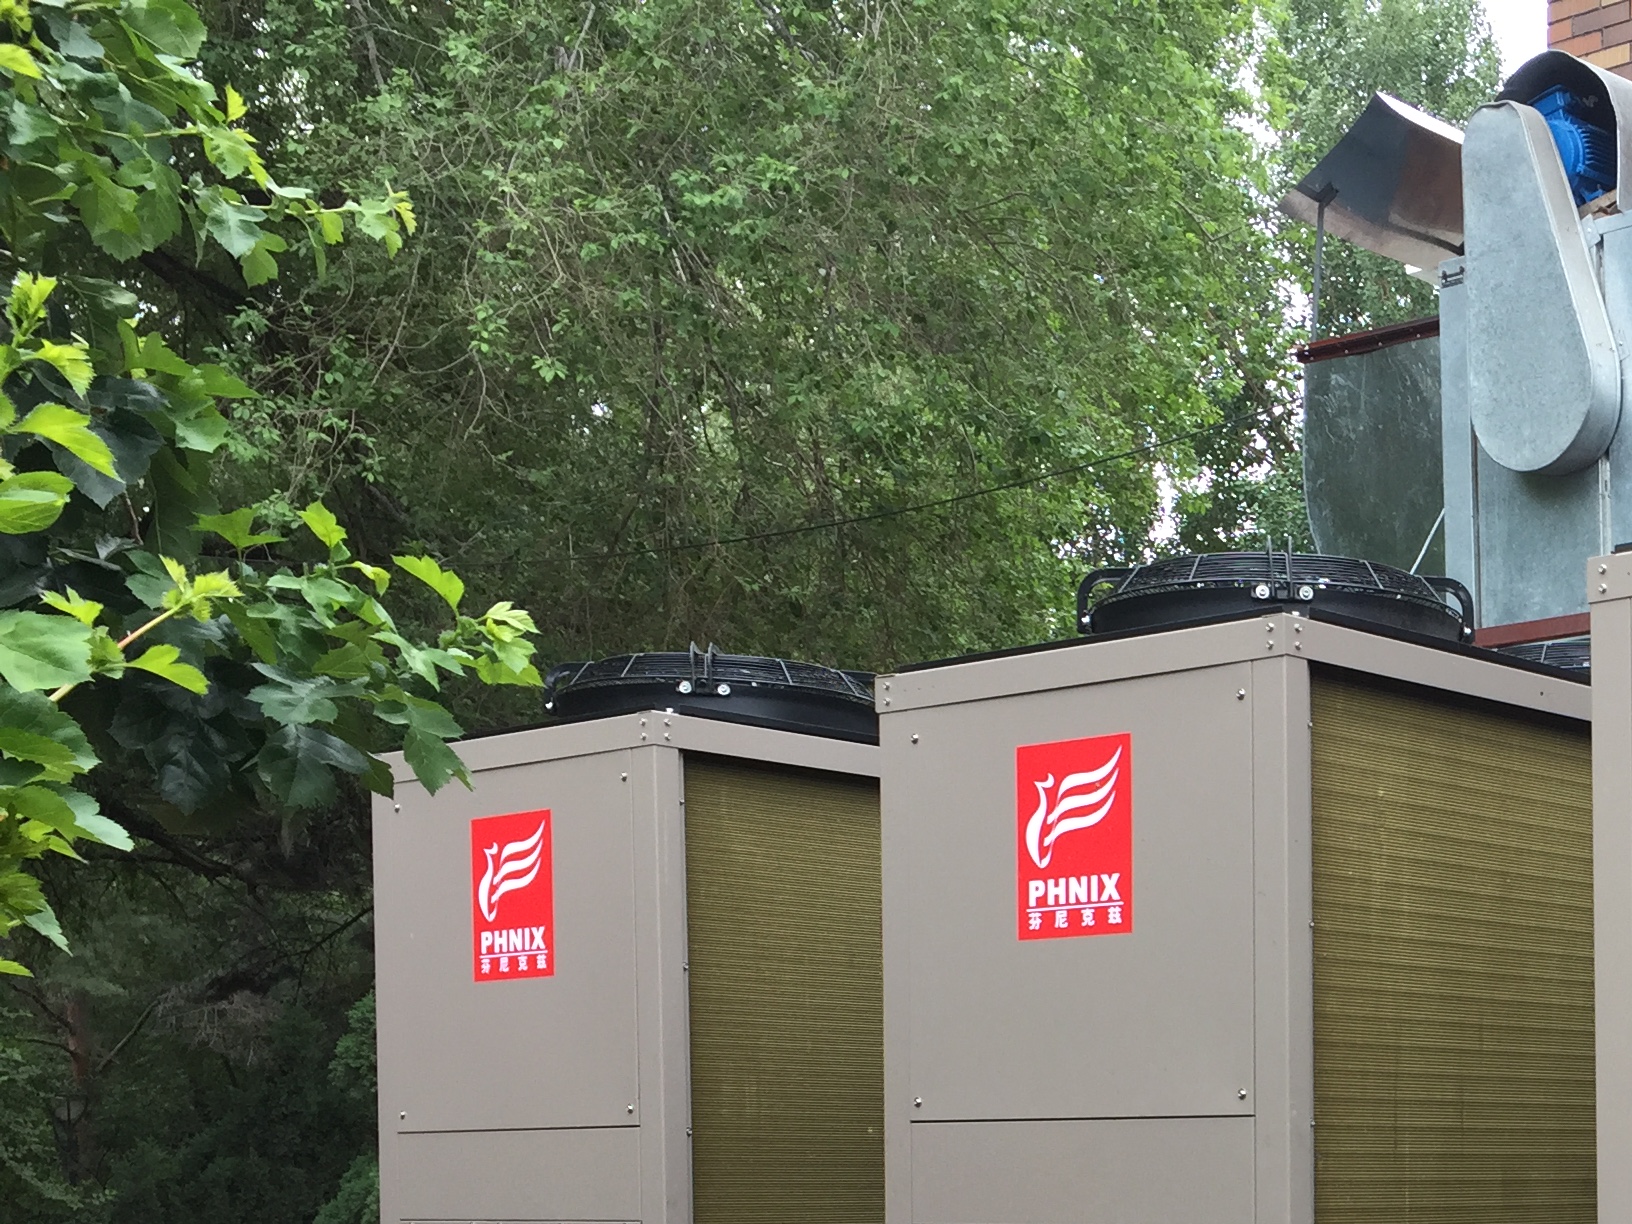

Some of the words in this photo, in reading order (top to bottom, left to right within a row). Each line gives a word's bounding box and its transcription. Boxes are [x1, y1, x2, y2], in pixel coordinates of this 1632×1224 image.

[1028, 873, 1121, 908] PHNIX
[1028, 906, 1123, 931] 芬尼克兹
[480, 926, 546, 954] PHNIX
